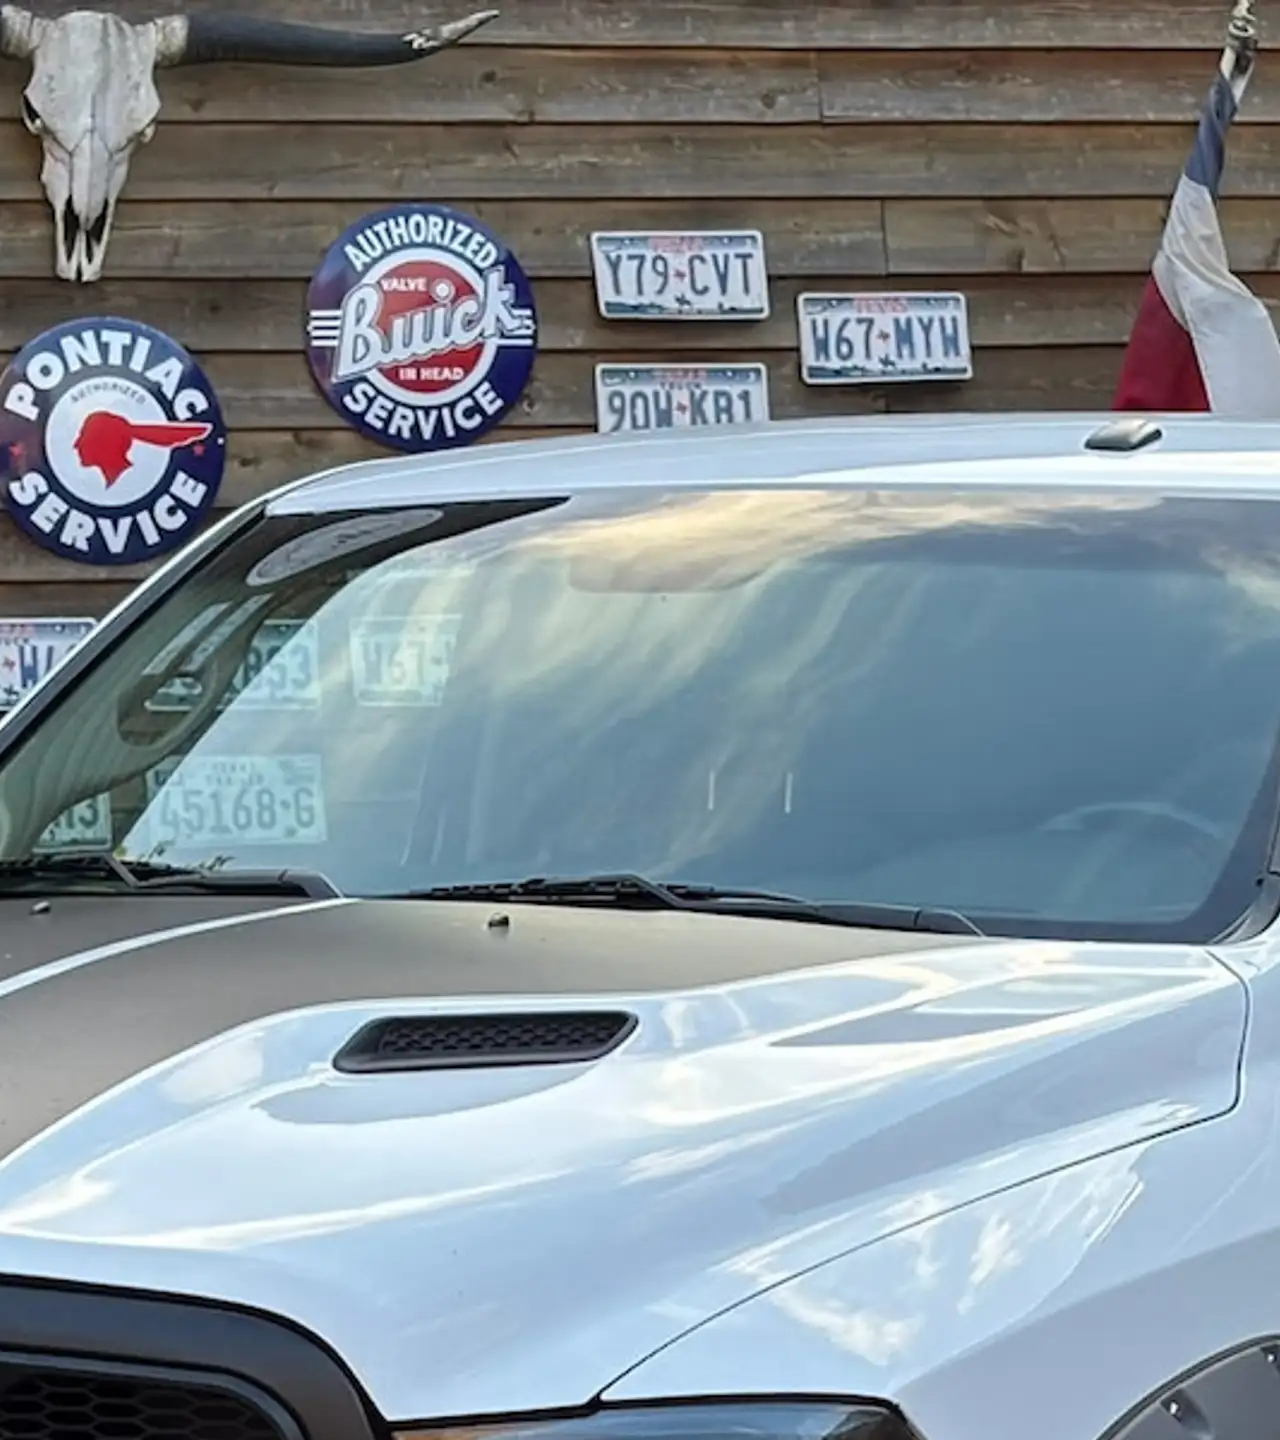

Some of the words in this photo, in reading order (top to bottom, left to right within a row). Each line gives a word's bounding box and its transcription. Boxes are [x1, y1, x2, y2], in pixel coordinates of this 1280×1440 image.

[344, 214, 498, 272] AUTHORIZED
[380, 277, 427, 292] VALVE
[605, 252, 669, 296] Y79
[687, 252, 754, 296] CVT
[331, 265, 518, 382] Buick
[4, 330, 209, 421] PONTIAC
[398, 367, 417, 380] IN
[420, 367, 465, 381] HEAD
[343, 383, 504, 440] SERVICE
[9, 471, 208, 554] SERVICE
